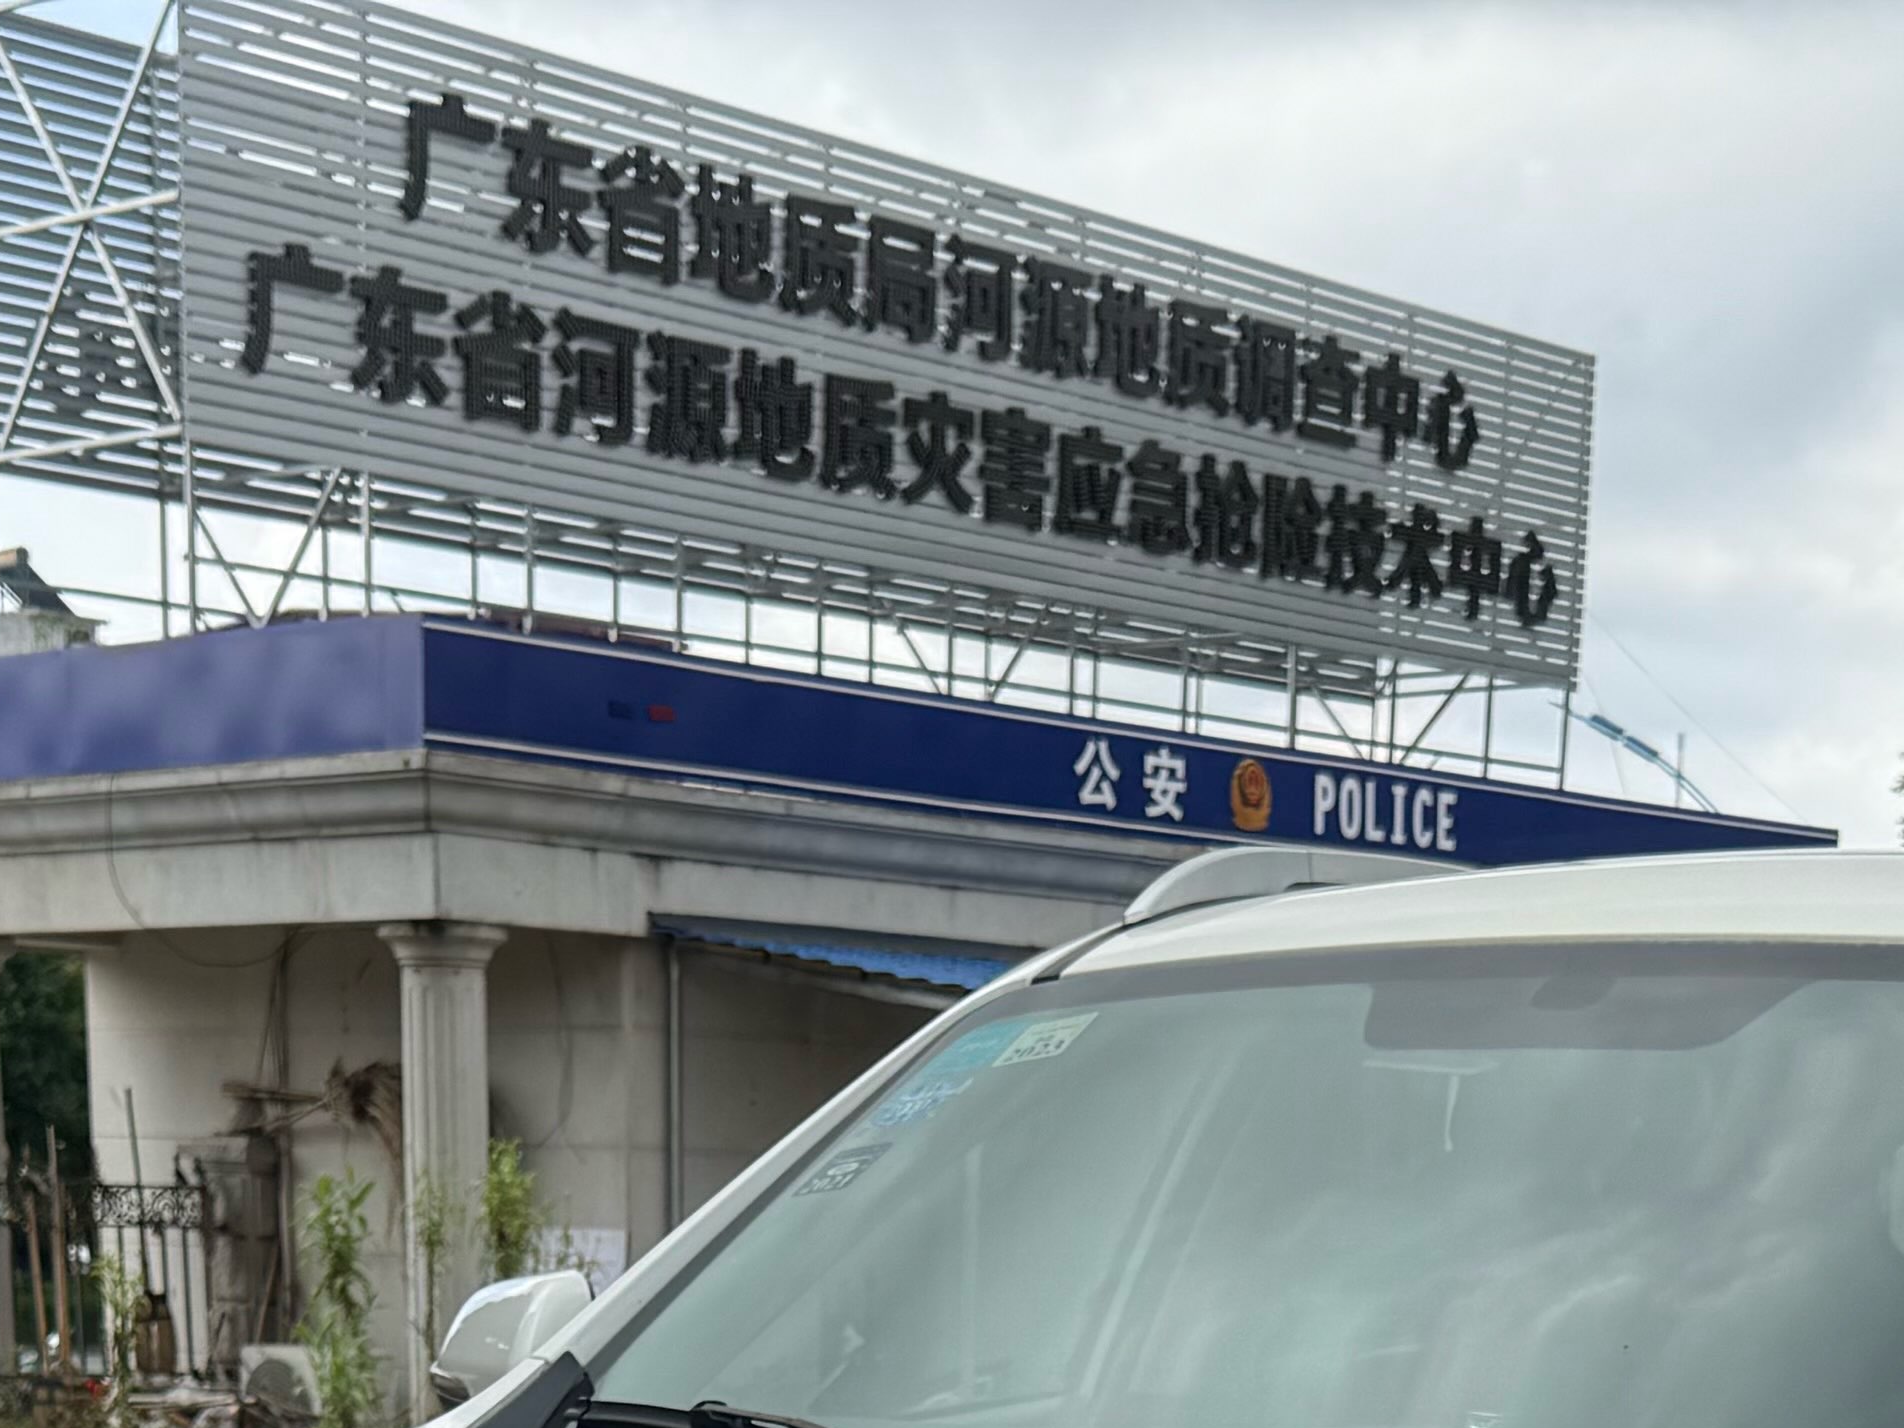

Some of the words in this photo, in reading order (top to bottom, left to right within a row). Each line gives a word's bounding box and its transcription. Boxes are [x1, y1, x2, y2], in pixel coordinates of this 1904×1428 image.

[400, 93, 1480, 472] 广东省地质局河源地质调查中心
[241, 242, 1558, 628] 广东省河源地质灾害应急抢险技术中心
[1072, 737, 1188, 822] 公安
[1313, 771, 1459, 853] POLICE
